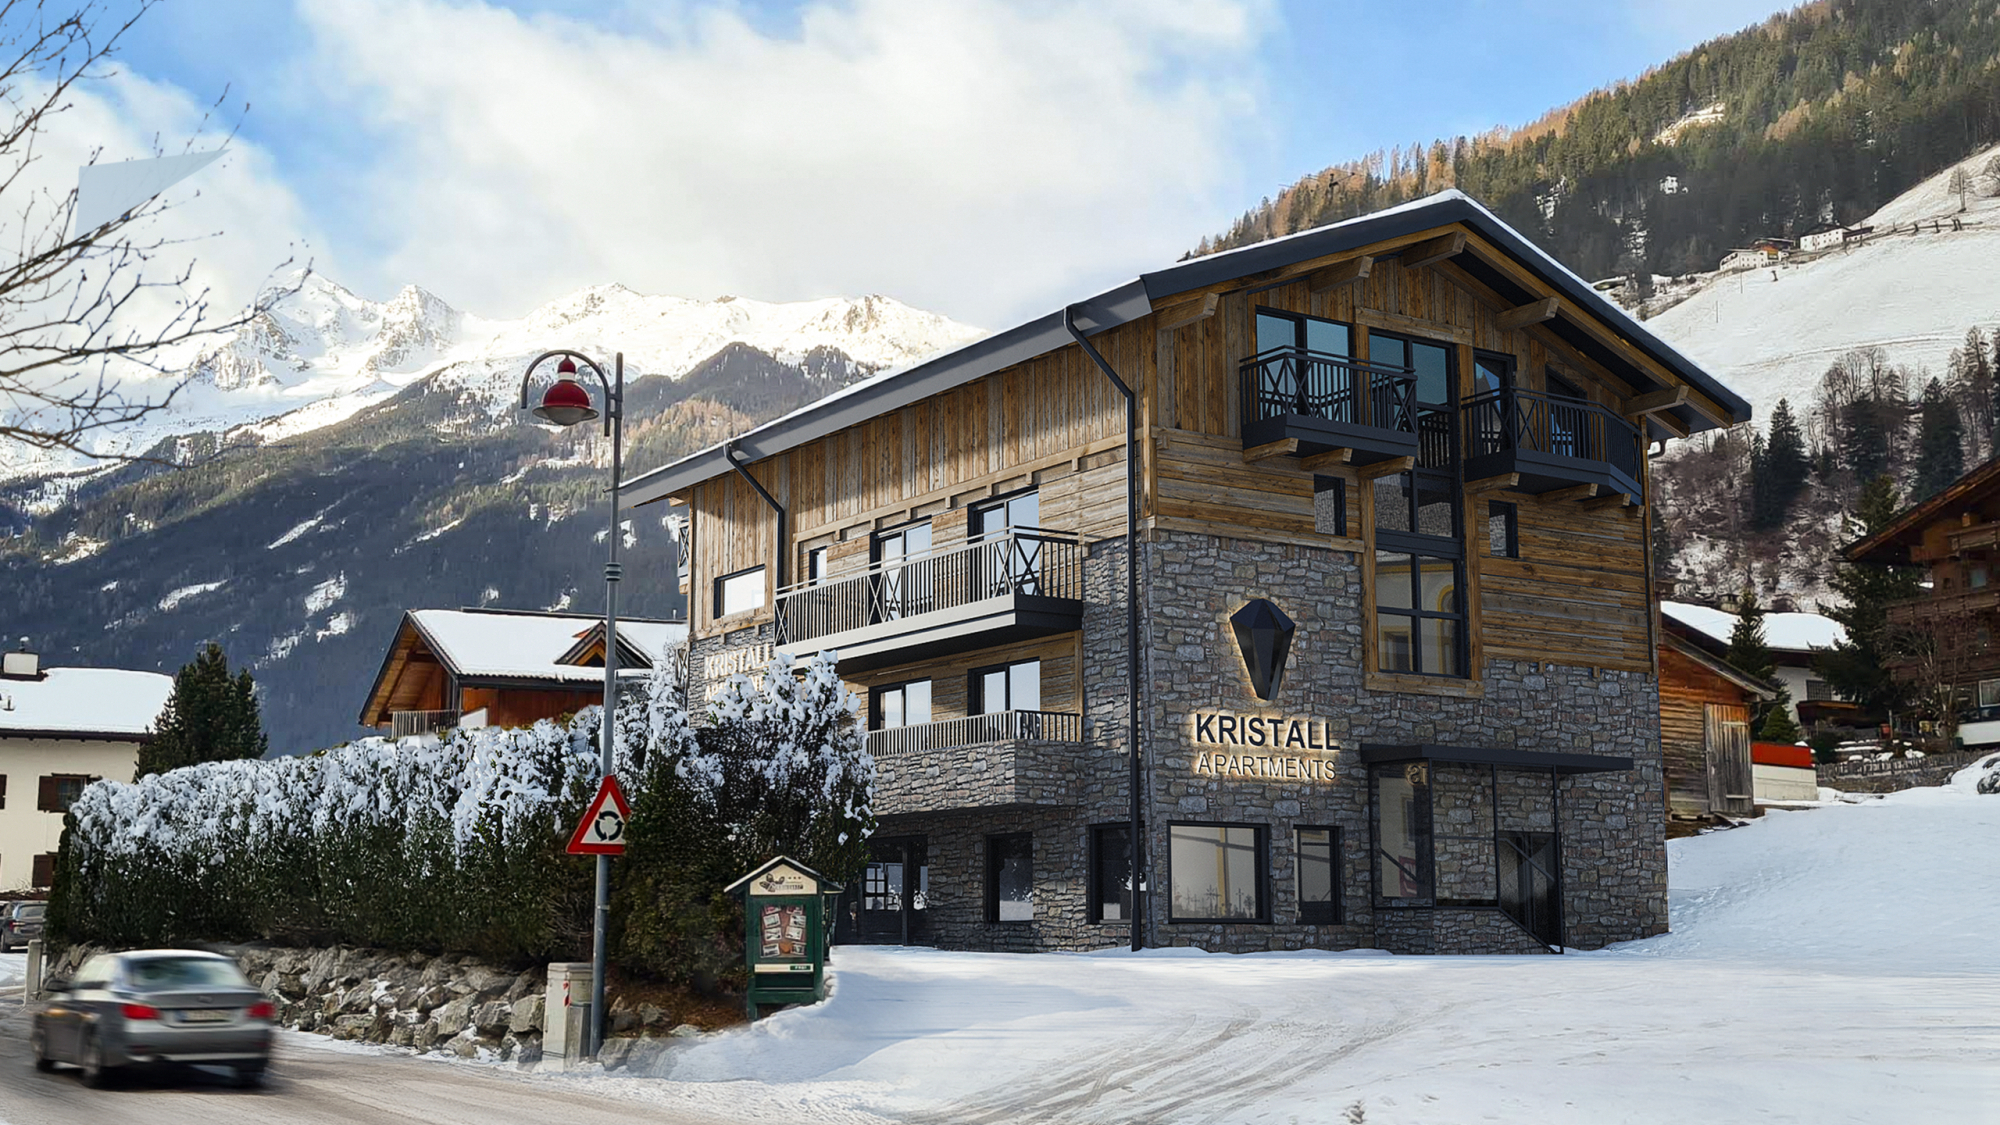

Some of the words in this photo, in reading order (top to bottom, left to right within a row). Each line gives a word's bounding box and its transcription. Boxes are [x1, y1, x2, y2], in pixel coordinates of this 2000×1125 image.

[704, 644, 770, 679] KRISTALL
[1196, 714, 1341, 750] KRISTALL
[1197, 753, 1337, 780] APARTMENTS
